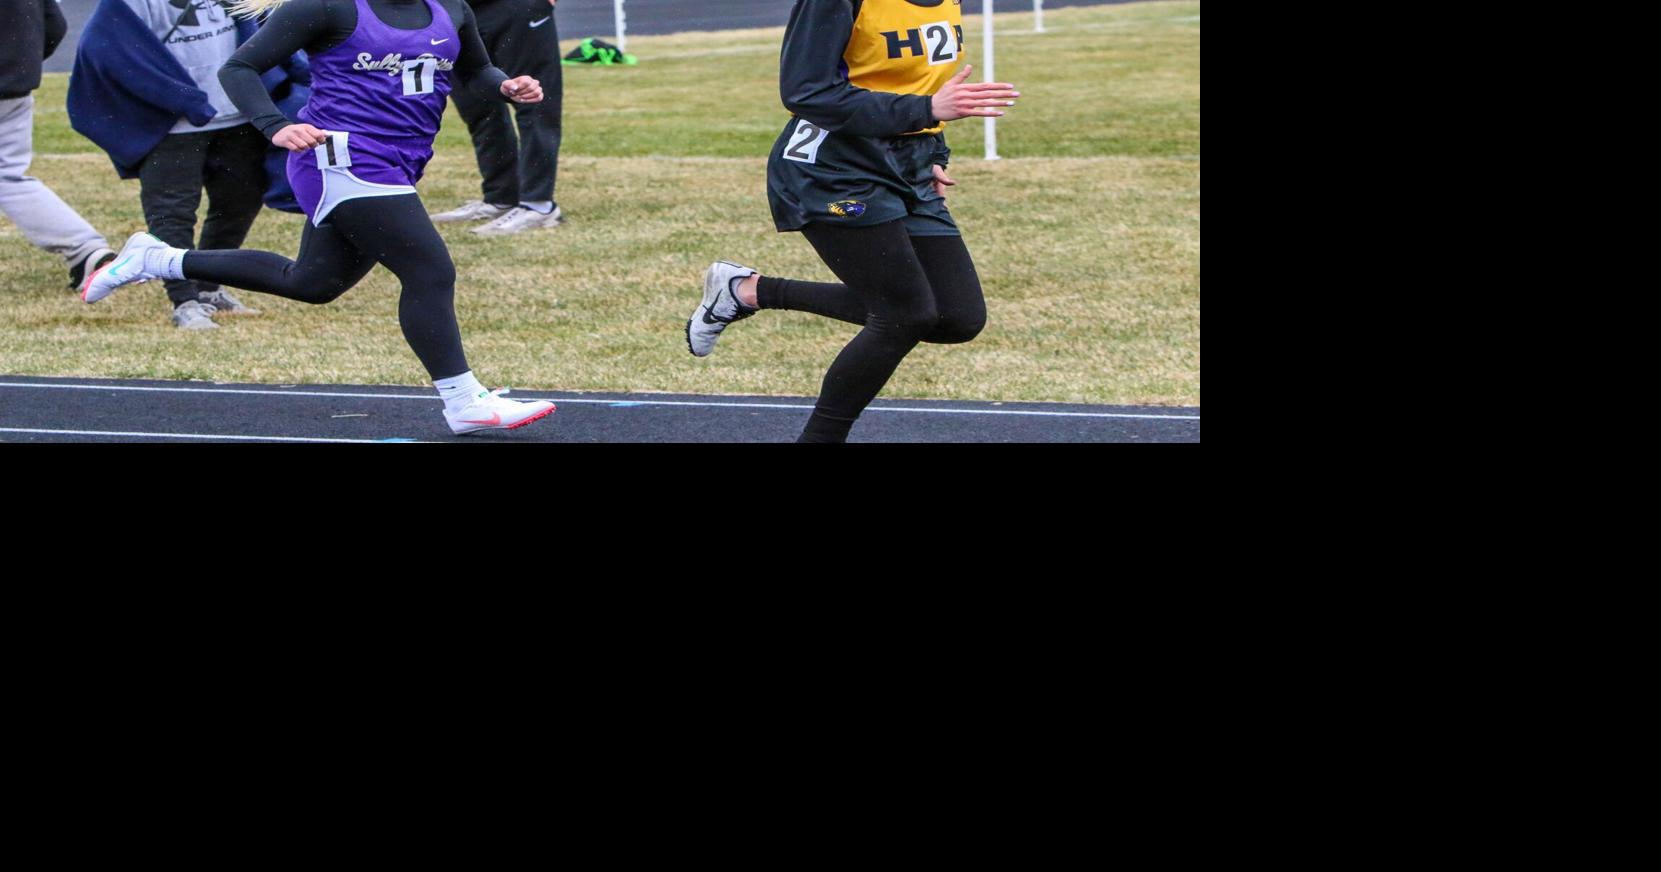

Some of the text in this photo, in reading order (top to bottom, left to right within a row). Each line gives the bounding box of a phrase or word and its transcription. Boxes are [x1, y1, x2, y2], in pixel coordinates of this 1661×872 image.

[168, 32, 213, 44] UNDER
[926, 25, 953, 62] 2
[352, 52, 405, 77] Sully
[408, 62, 425, 92] 1
[324, 134, 337, 166] 1
[787, 123, 820, 160] 2
